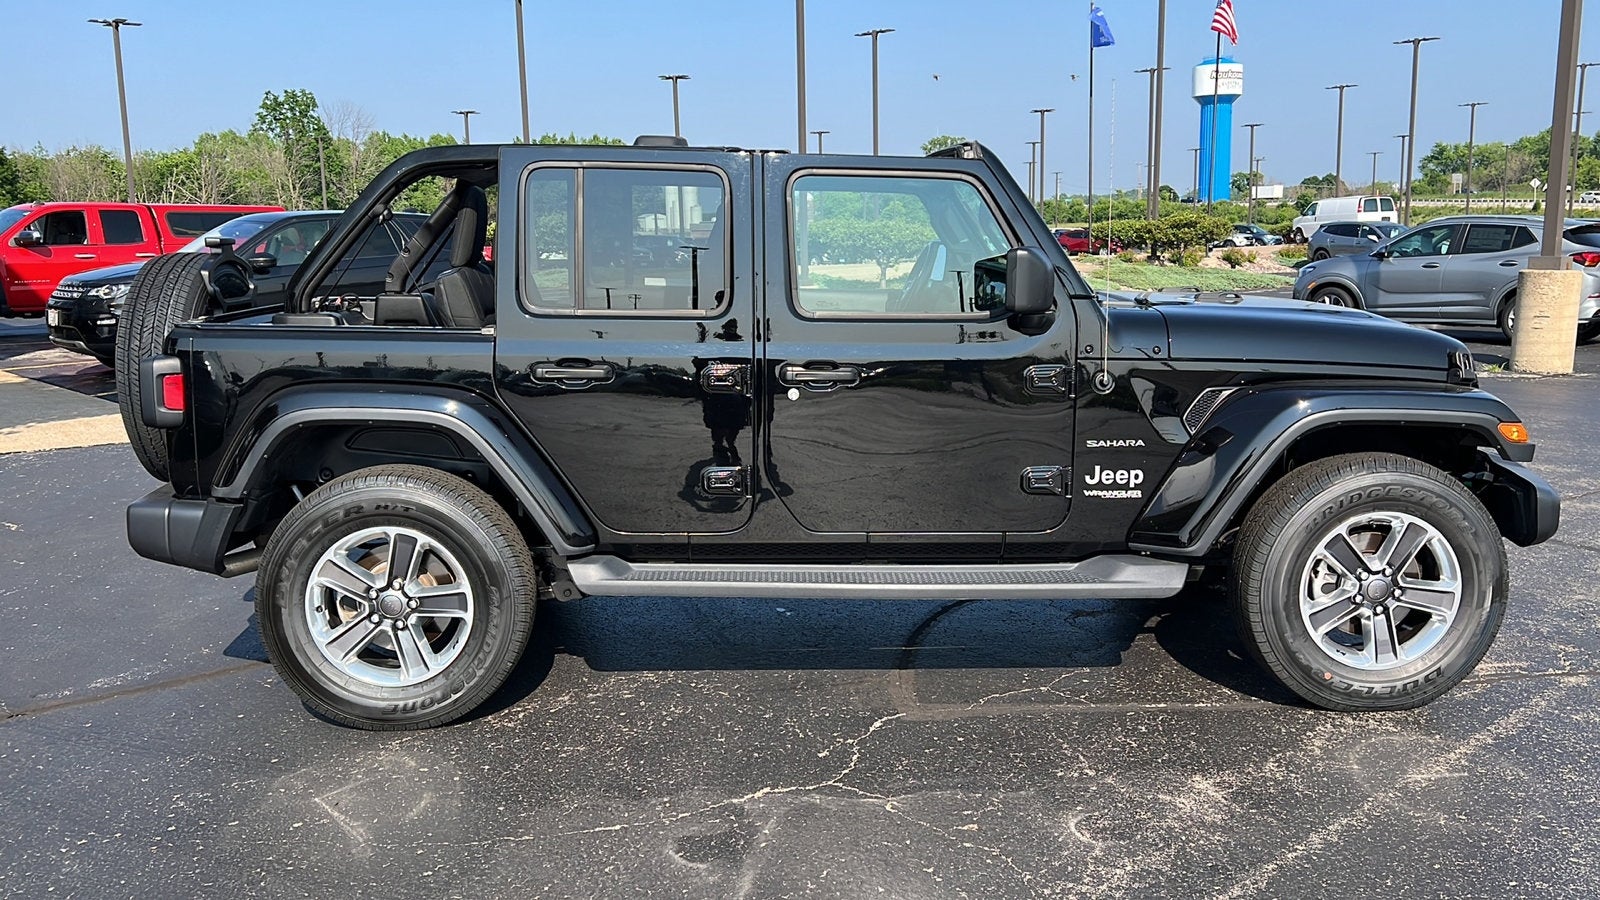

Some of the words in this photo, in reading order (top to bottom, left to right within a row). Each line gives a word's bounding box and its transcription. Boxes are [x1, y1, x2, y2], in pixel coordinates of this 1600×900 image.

[1086, 439, 1146, 448] SAHARA
[1084, 465, 1144, 488] Jeep
[373, 502, 417, 513] H/T
[1305, 485, 1476, 535] BRIDGESTONE
